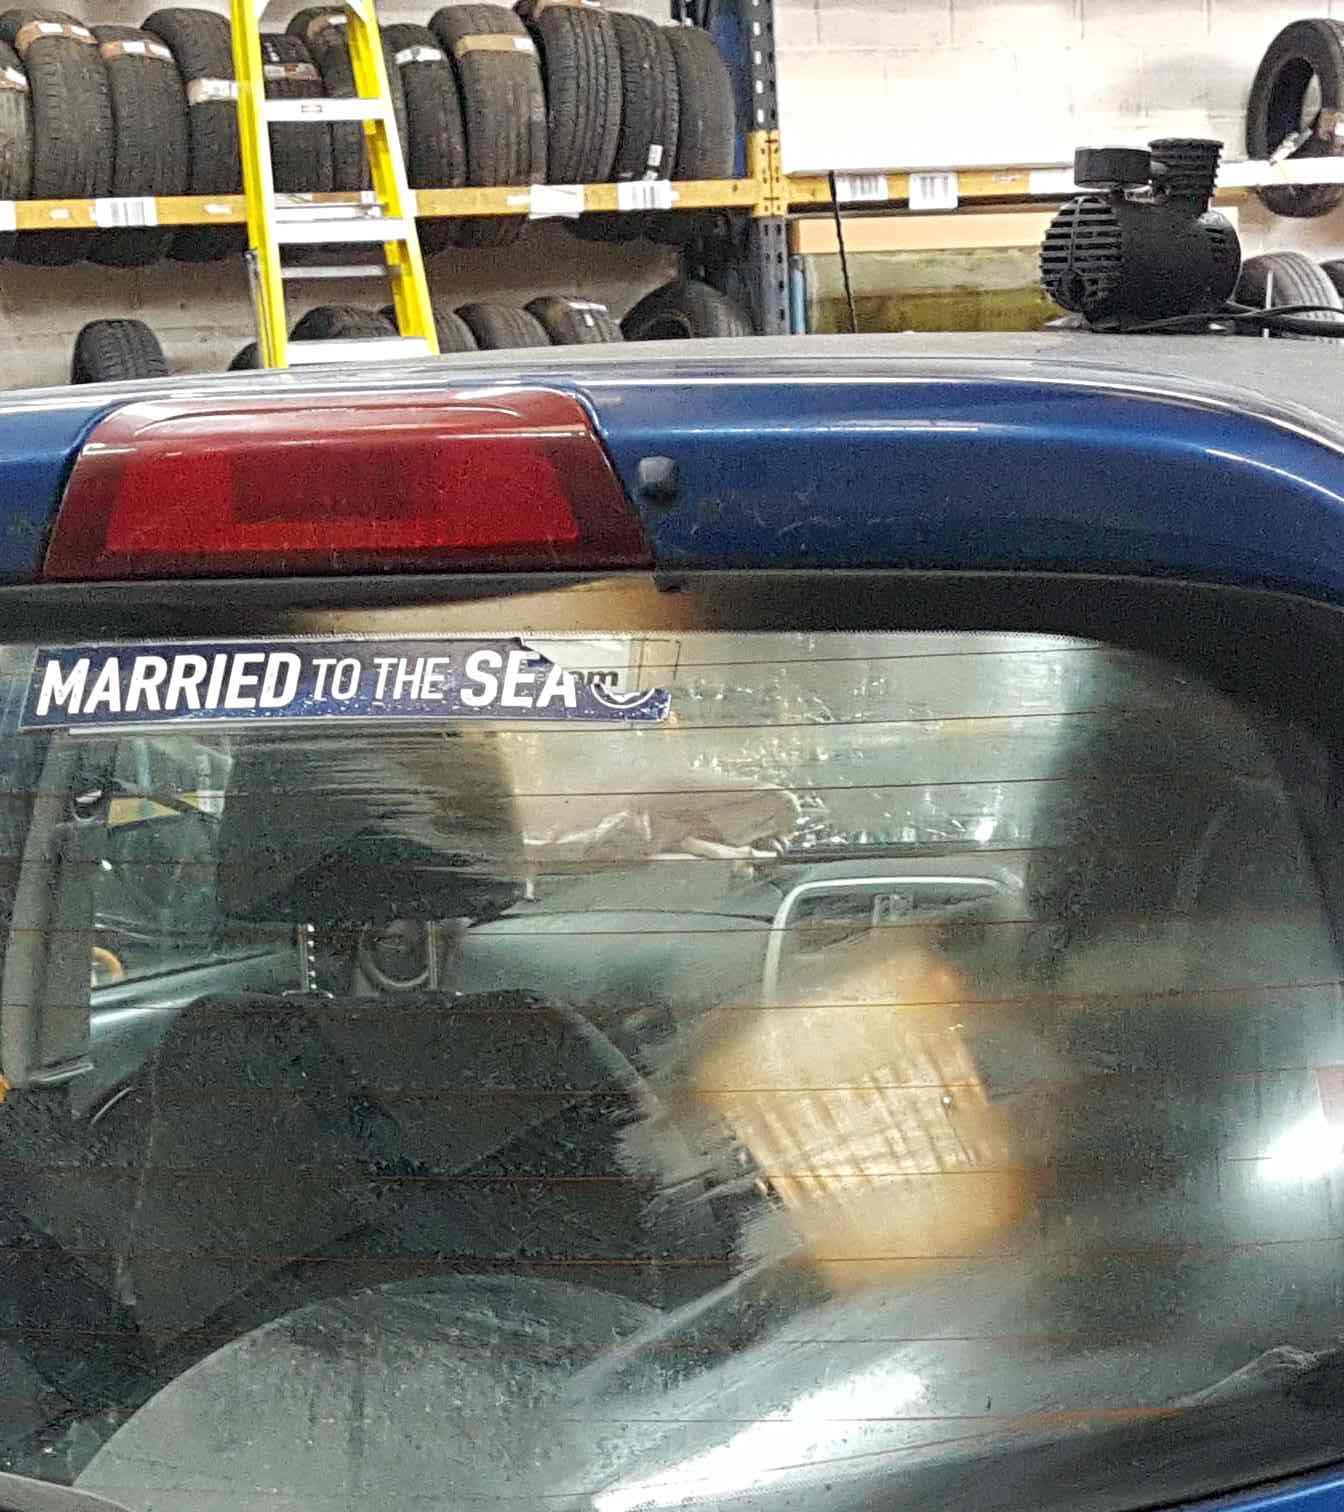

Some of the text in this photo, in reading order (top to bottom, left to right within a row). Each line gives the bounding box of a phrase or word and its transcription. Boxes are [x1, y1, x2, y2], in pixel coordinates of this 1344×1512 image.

[35, 649, 577, 716] MARRIED TO THE SEA
